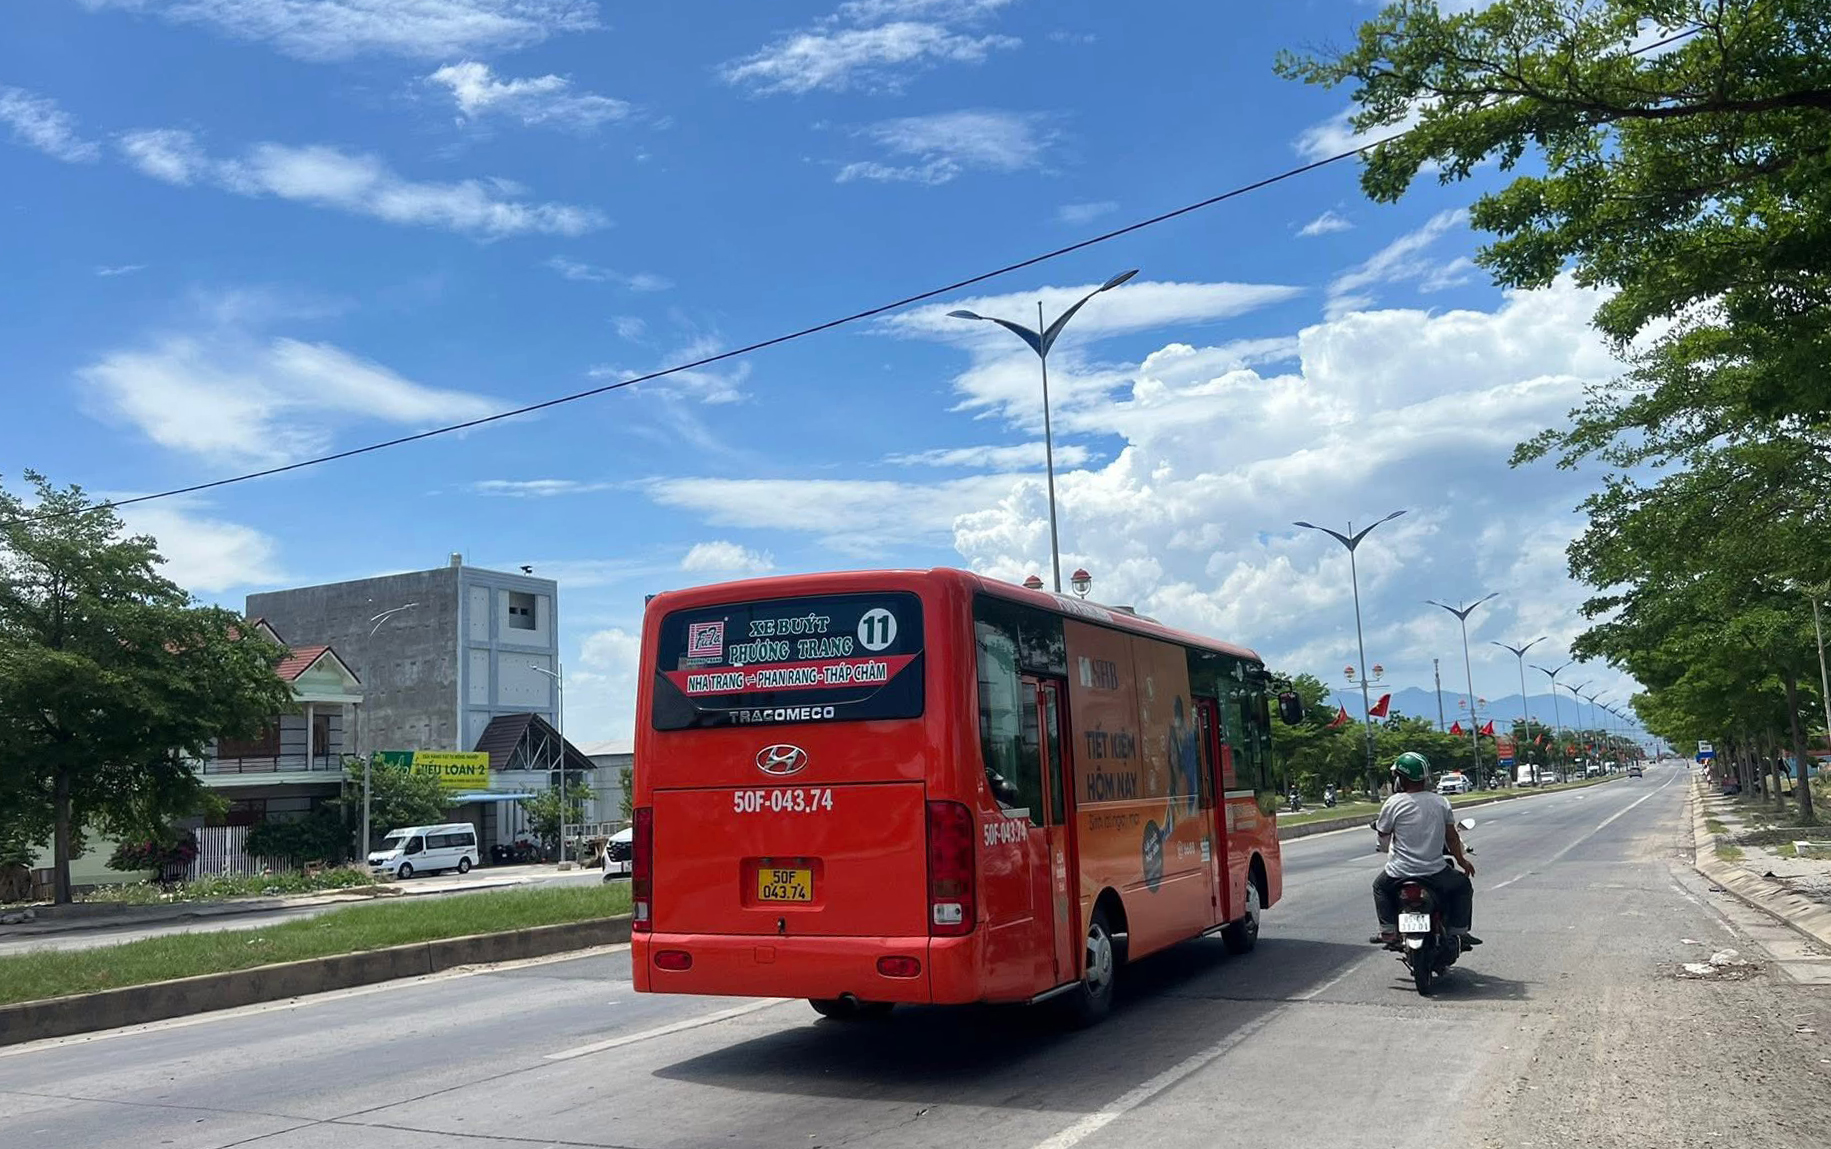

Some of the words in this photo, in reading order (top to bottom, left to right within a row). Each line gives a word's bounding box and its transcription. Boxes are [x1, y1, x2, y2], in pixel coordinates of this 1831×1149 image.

[749, 620, 774, 636] XE
[777, 613, 830, 635] BUÝT
[863, 615, 889, 644] 11
[729, 638, 790, 664] PHƯƠNG
[798, 636, 854, 658] TRANG
[687, 675, 708, 692] NHA
[710, 673, 744, 690] TRANG
[757, 670, 787, 687] PHAN
[787, 668, 817, 686] RANG
[824, 662, 852, 683] THÁP
[852, 660, 887, 682] CHÀM
[729, 706, 835, 723] TRACOMECO
[445, 765, 475, 775] LOAN
[478, 765, 485, 775] 2
[1087, 765, 1114, 801] HÔM
[1116, 771, 1137, 798] NAY
[733, 789, 833, 813] 50F-043.74
[772, 871, 796, 884] 50F
[763, 885, 805, 899] 043.74
